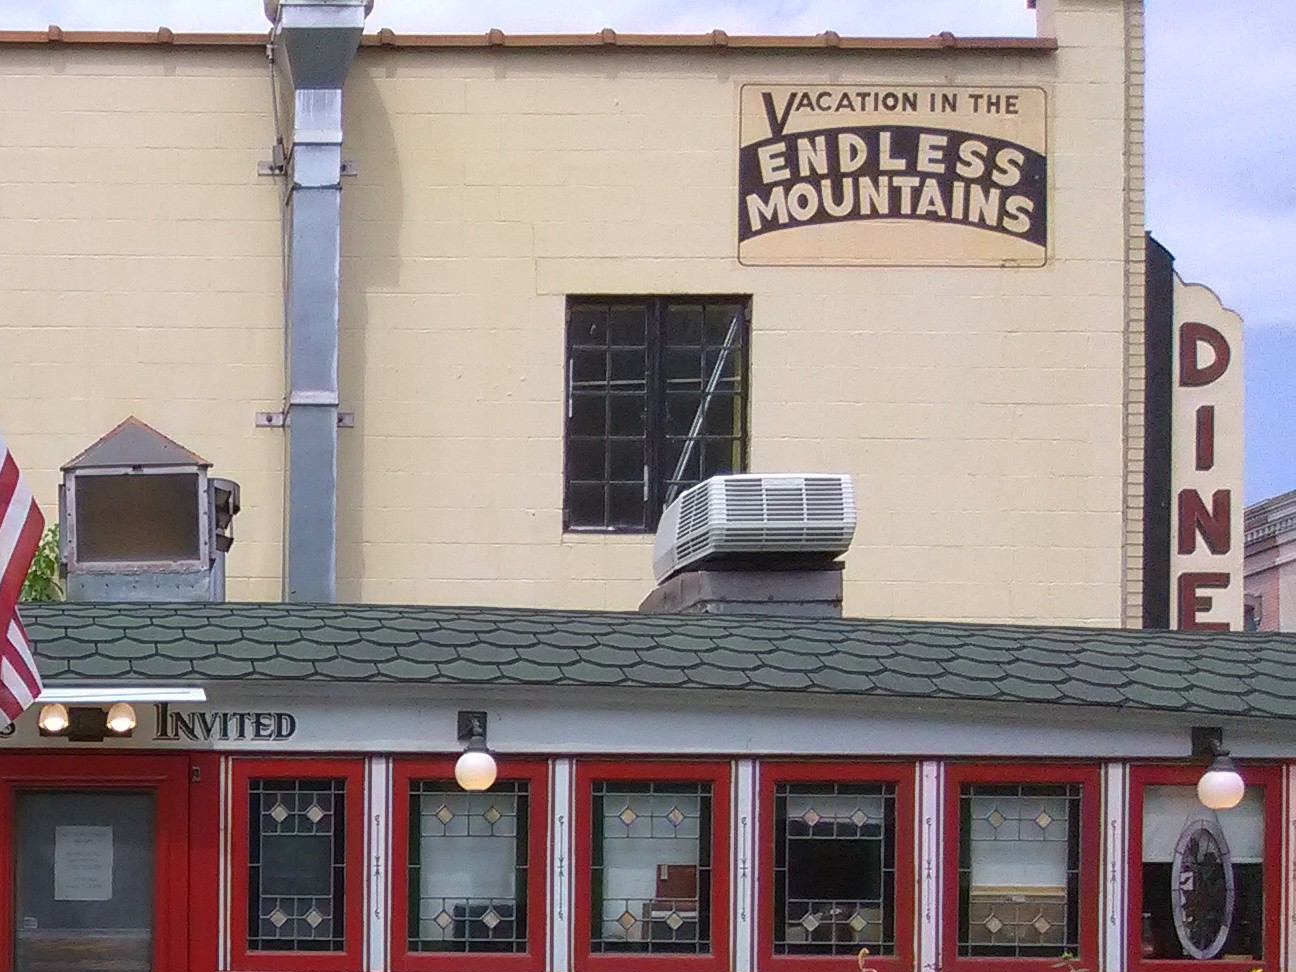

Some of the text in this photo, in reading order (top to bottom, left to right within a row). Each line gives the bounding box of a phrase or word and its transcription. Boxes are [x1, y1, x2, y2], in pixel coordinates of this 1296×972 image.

[760, 91, 1020, 137] VACATION IN THE
[757, 131, 1025, 187] ENDLESS
[745, 176, 1035, 233] MOUNTAINS
[152, 702, 297, 742] INVITED
